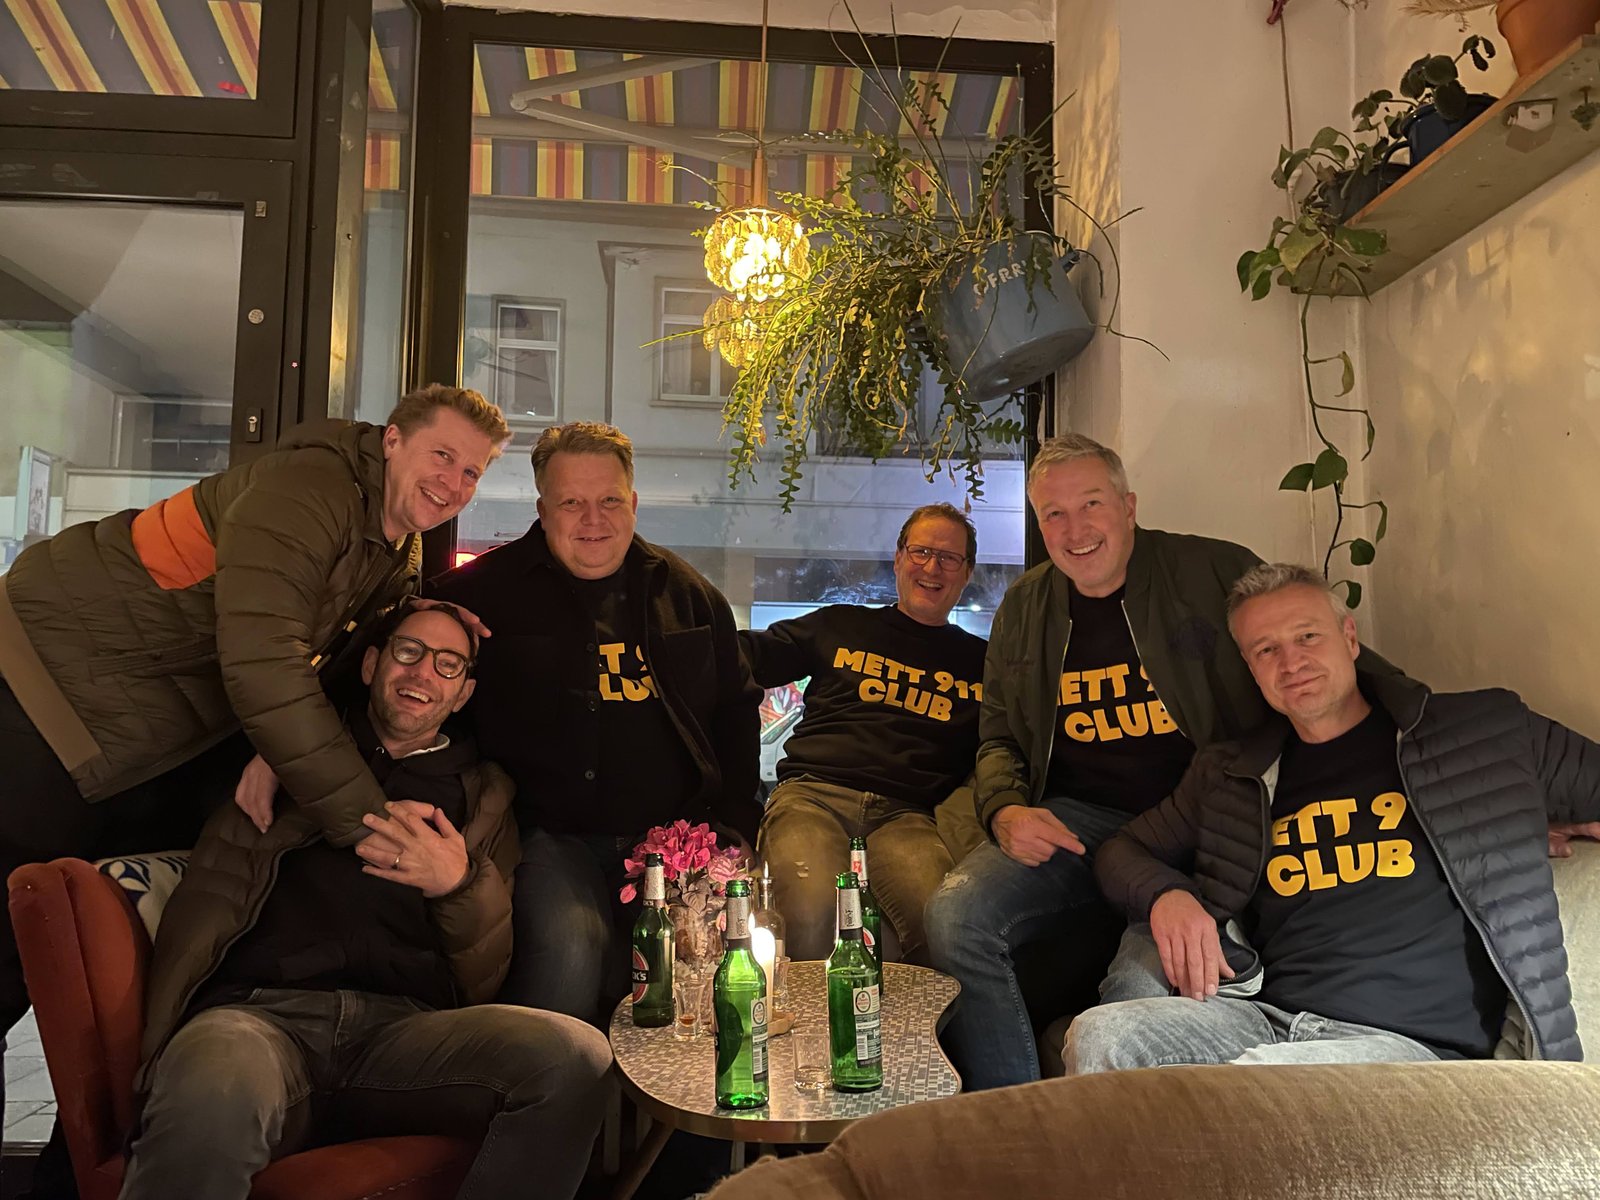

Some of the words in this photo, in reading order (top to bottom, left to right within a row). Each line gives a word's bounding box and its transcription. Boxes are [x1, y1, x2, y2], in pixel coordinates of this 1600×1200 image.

[833, 647, 926, 683] METT
[934, 671, 983, 702] 911
[1057, 663, 1130, 706] ETT
[858, 678, 953, 722] CLUB
[1266, 839, 1416, 897] CLUB
